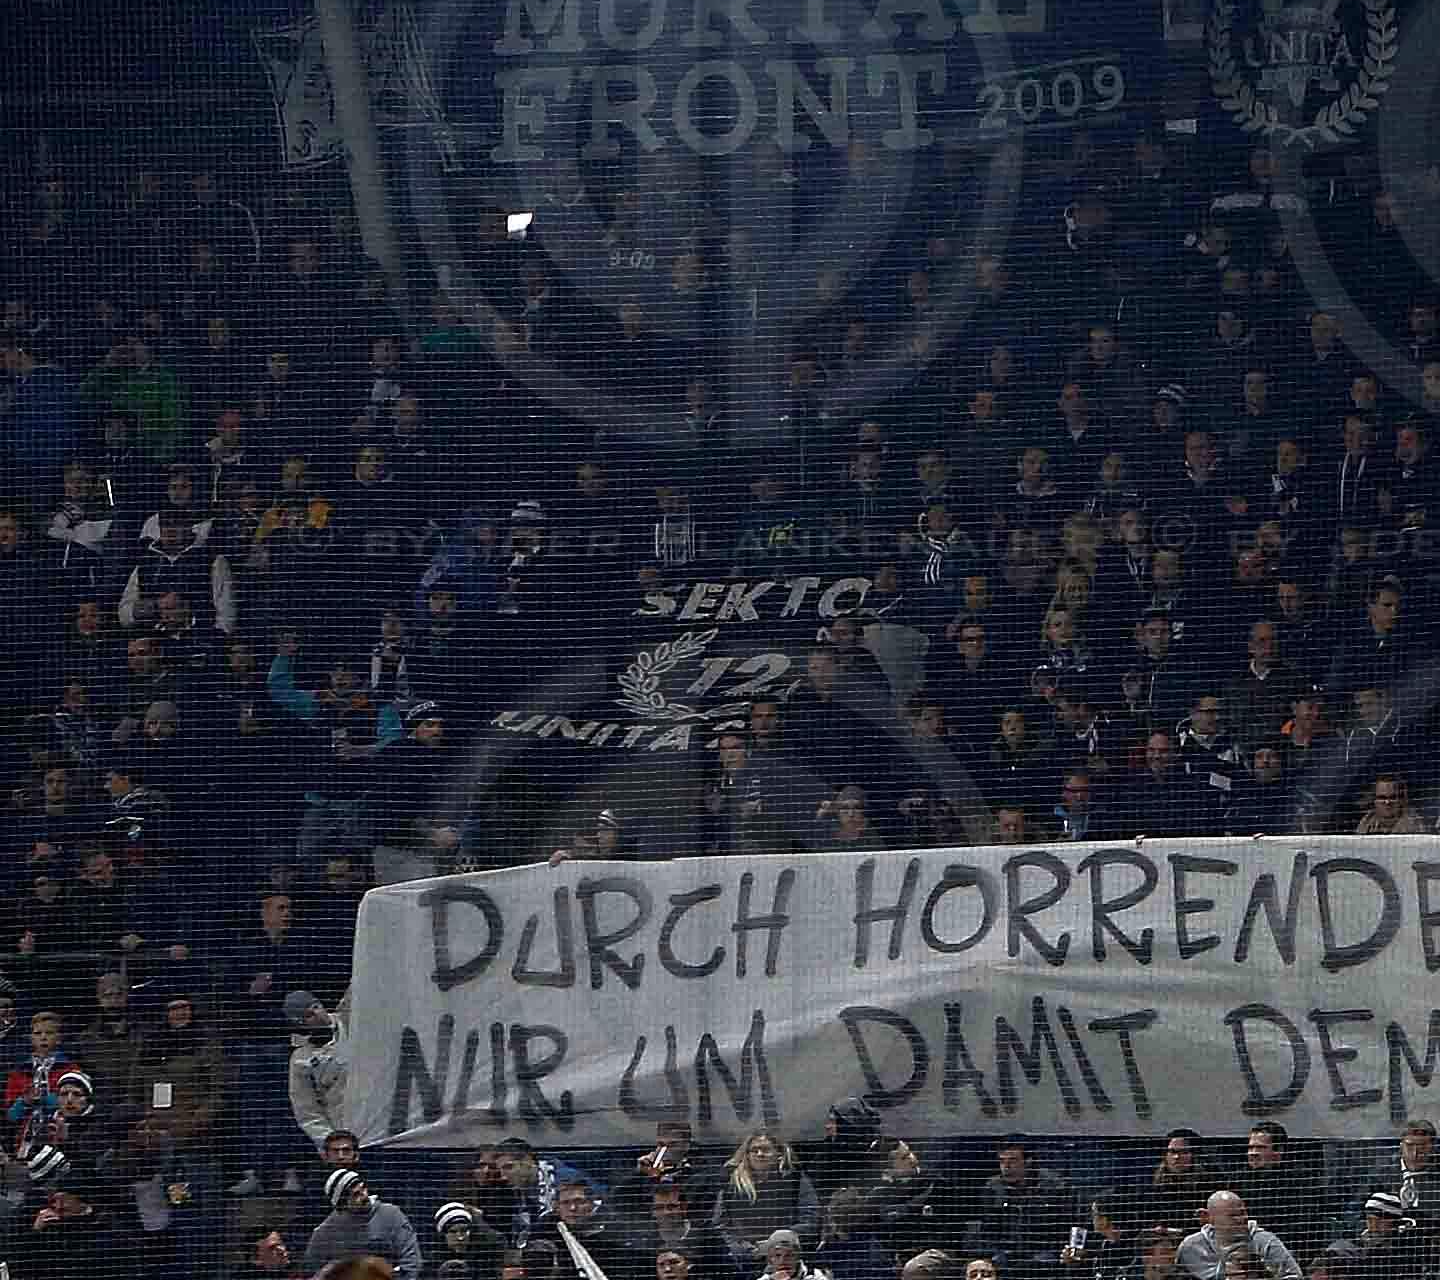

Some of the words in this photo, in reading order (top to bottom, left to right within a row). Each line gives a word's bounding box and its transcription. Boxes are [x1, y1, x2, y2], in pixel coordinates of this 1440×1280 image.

[488, 54, 950, 164] FRONT
[973, 64, 1127, 125] 2009
[633, 576, 876, 621] SEKTO
[418, 866, 797, 992] DURCH
[388, 1010, 577, 1134] NUR
[619, 1008, 774, 1125] UM
[839, 995, 1159, 1120] DAMIT
